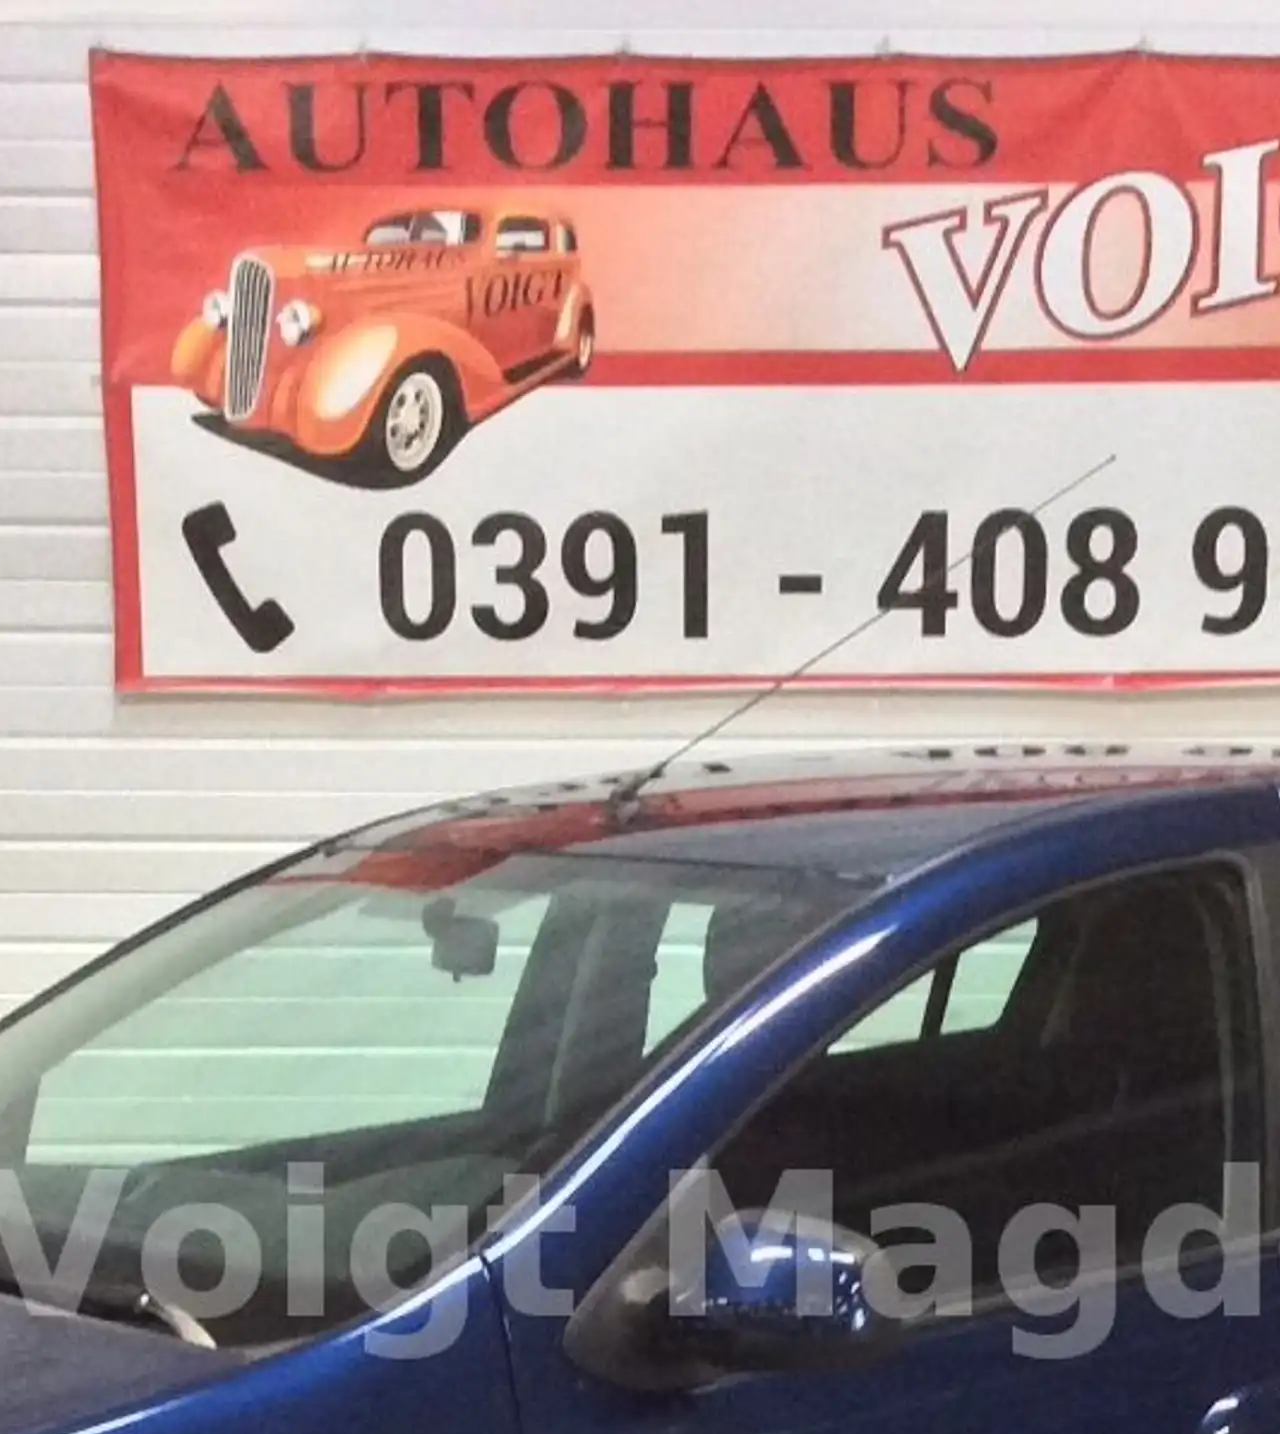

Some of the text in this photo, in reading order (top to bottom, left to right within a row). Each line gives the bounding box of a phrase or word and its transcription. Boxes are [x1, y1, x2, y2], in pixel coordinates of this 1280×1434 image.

[174, 76, 998, 174] AUTOHAUS
[465, 266, 563, 324] VOIGT
[377, 508, 710, 643] 0391
[778, 573, 824, 596] -
[875, 505, 1140, 639] 408
